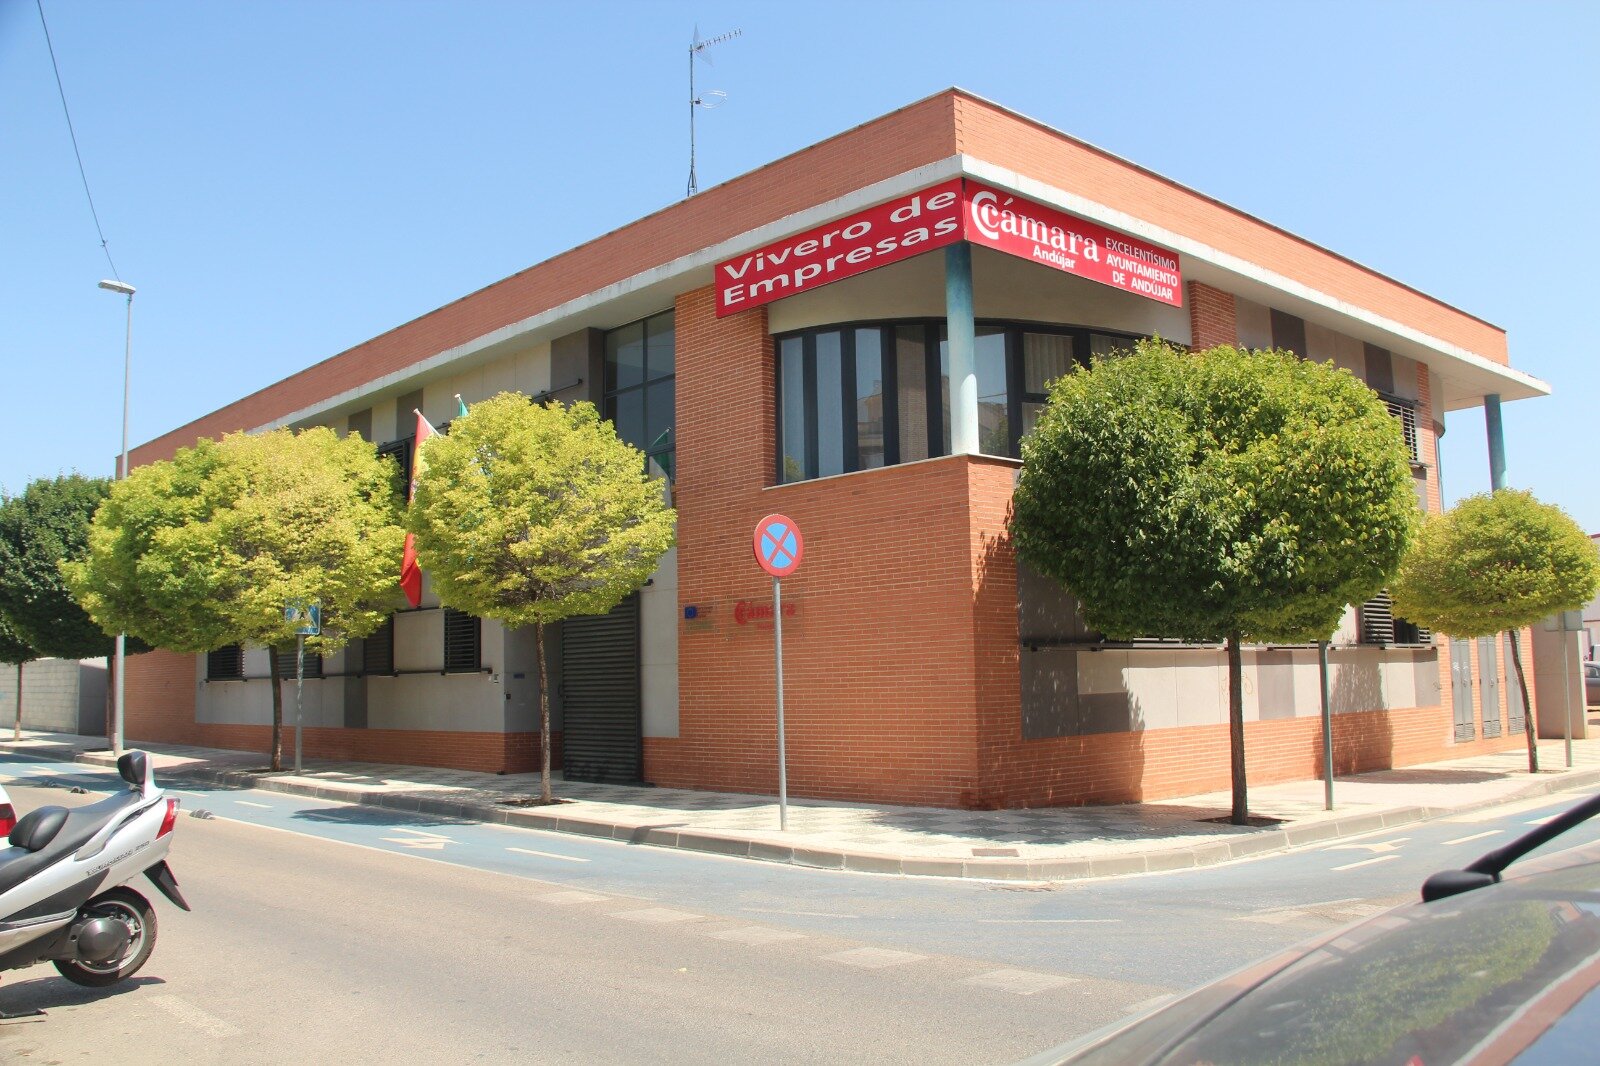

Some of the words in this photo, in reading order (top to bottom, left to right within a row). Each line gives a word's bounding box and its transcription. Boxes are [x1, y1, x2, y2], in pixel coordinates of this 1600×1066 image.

[723, 221, 872, 280] Vivero
[889, 191, 957, 223] de
[723, 216, 958, 307] Empresas
[1032, 244, 1076, 269] Andújar
[1105, 236, 1177, 272] EXCELENTÍSIMO
[1106, 253, 1178, 287] AYUNTAMIENTO
[1112, 270, 1126, 286] DE
[1131, 277, 1174, 301] ANDÚJAR
